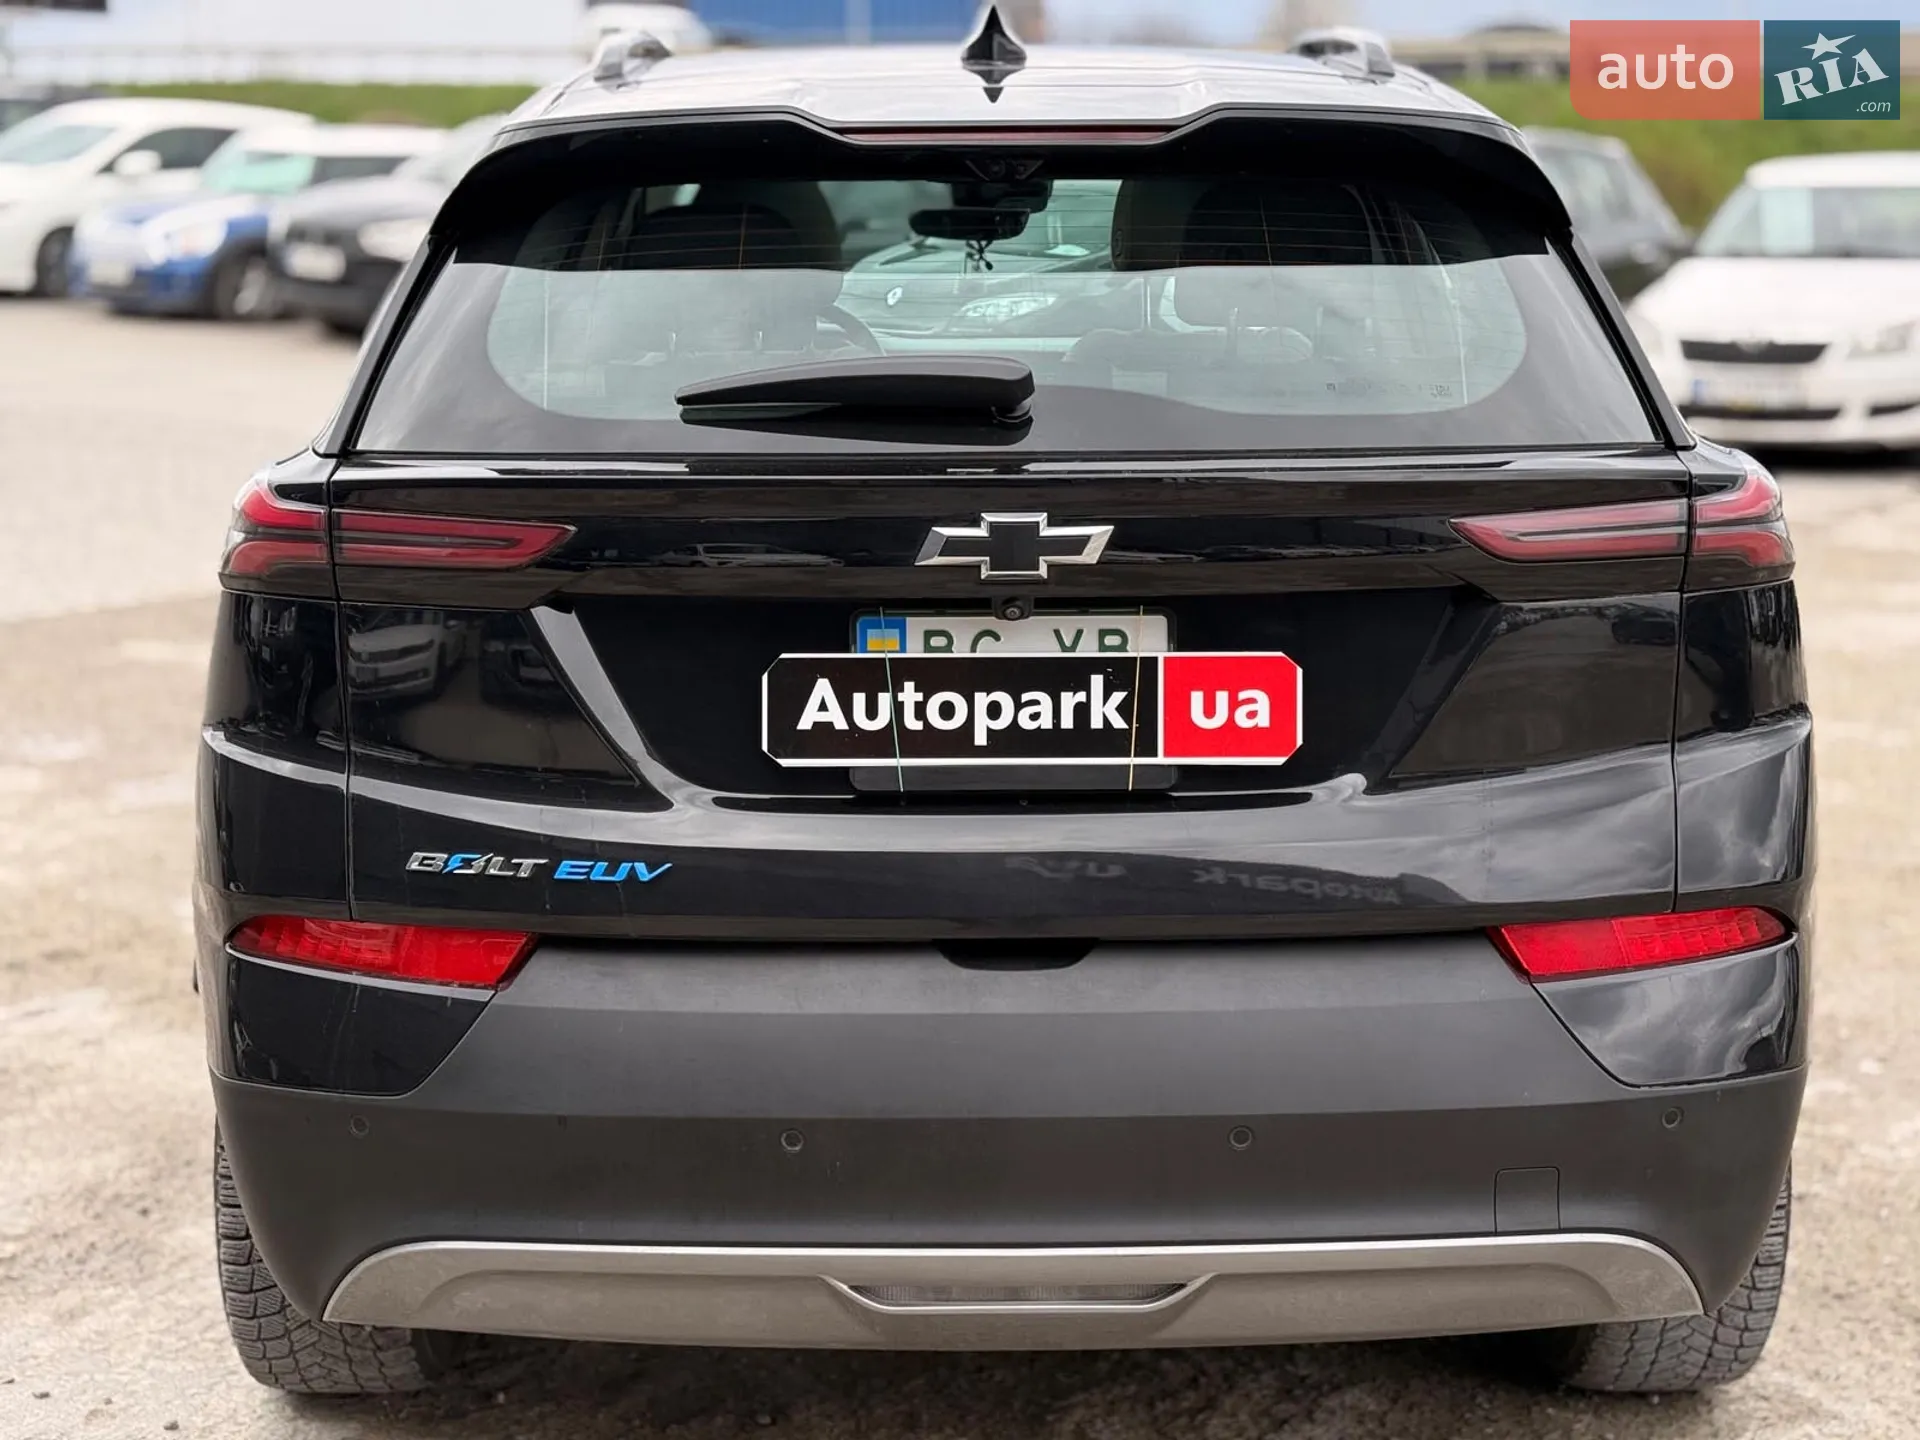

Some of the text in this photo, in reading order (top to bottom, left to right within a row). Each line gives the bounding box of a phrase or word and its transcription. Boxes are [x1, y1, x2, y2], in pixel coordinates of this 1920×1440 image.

[796, 674, 1271, 747] Autopark ua
[405, 851, 673, 882] BOLT EUV
